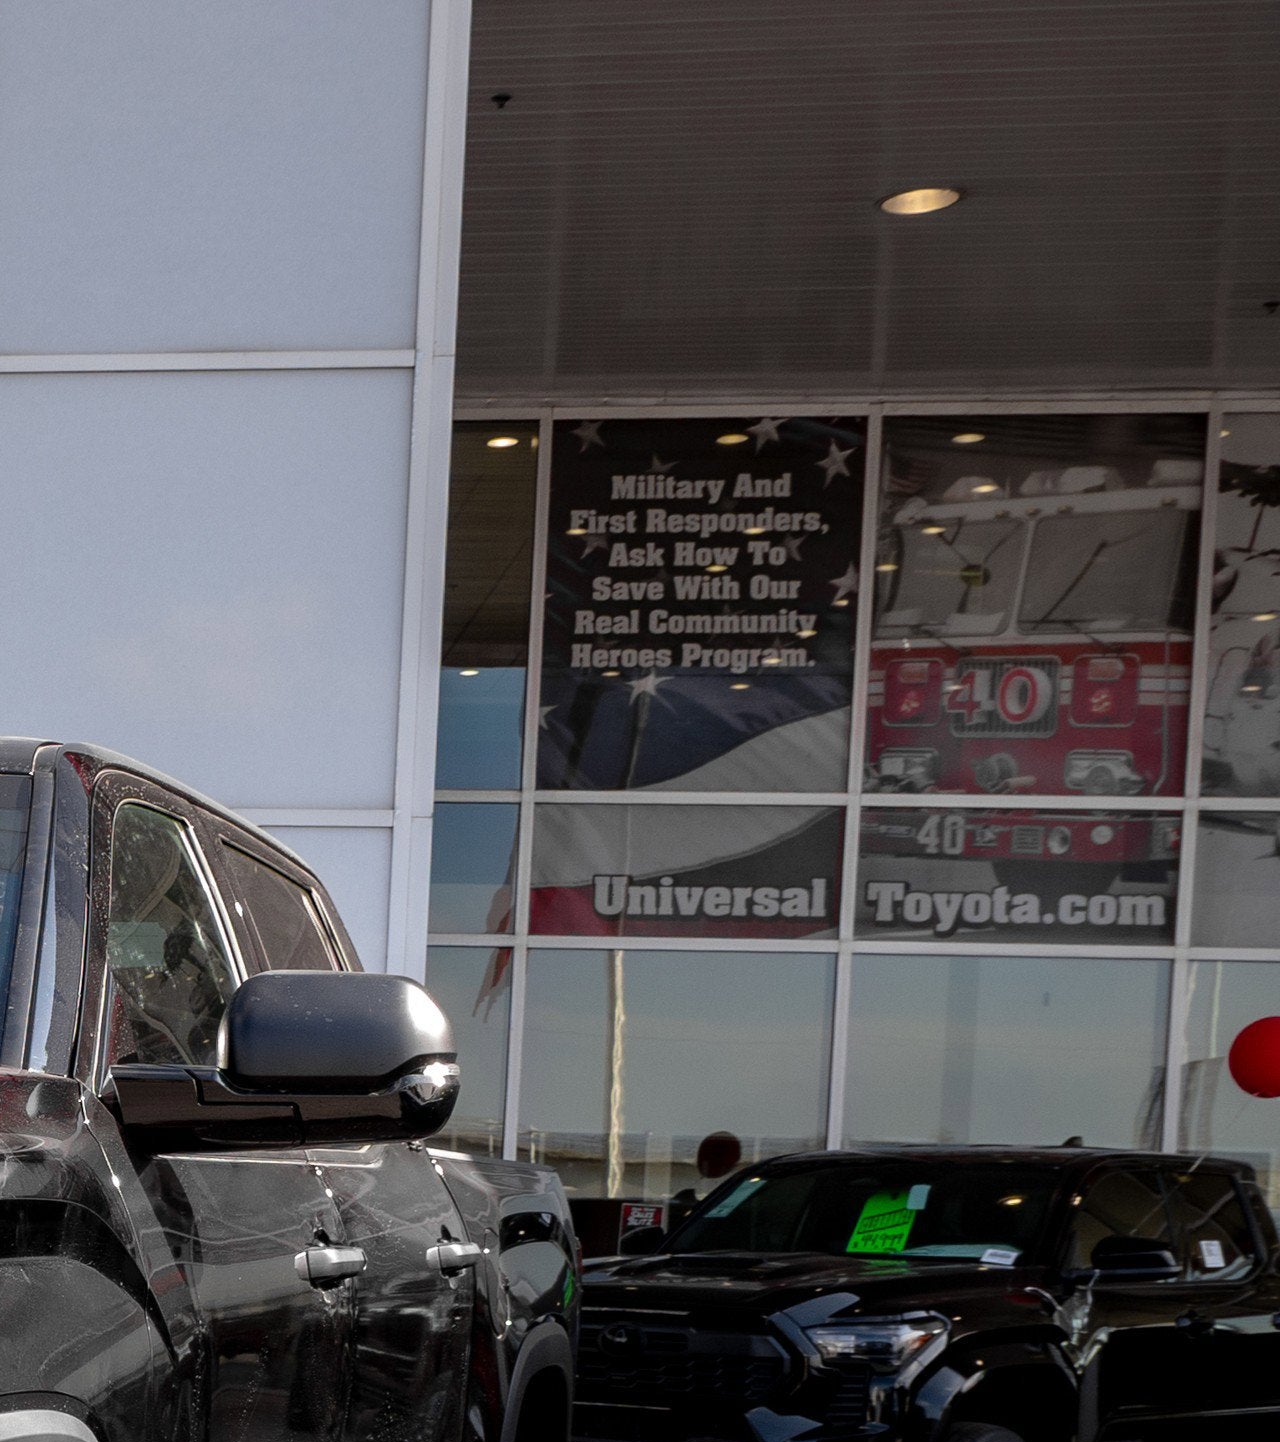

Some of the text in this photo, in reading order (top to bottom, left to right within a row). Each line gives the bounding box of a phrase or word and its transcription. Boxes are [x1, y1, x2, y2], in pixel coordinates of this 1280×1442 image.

[611, 473, 791, 504] Military And
[569, 507, 829, 538] First Responders,
[609, 541, 787, 567] Ask How To
[592, 575, 802, 601] Save With Our
[574, 609, 818, 639] Real Community
[570, 643, 816, 673] Heroes Program.
[945, 666, 1052, 725] 40
[916, 815, 966, 856] 40
[593, 875, 827, 918] Universal
[867, 881, 1168, 932] Toyota.com
